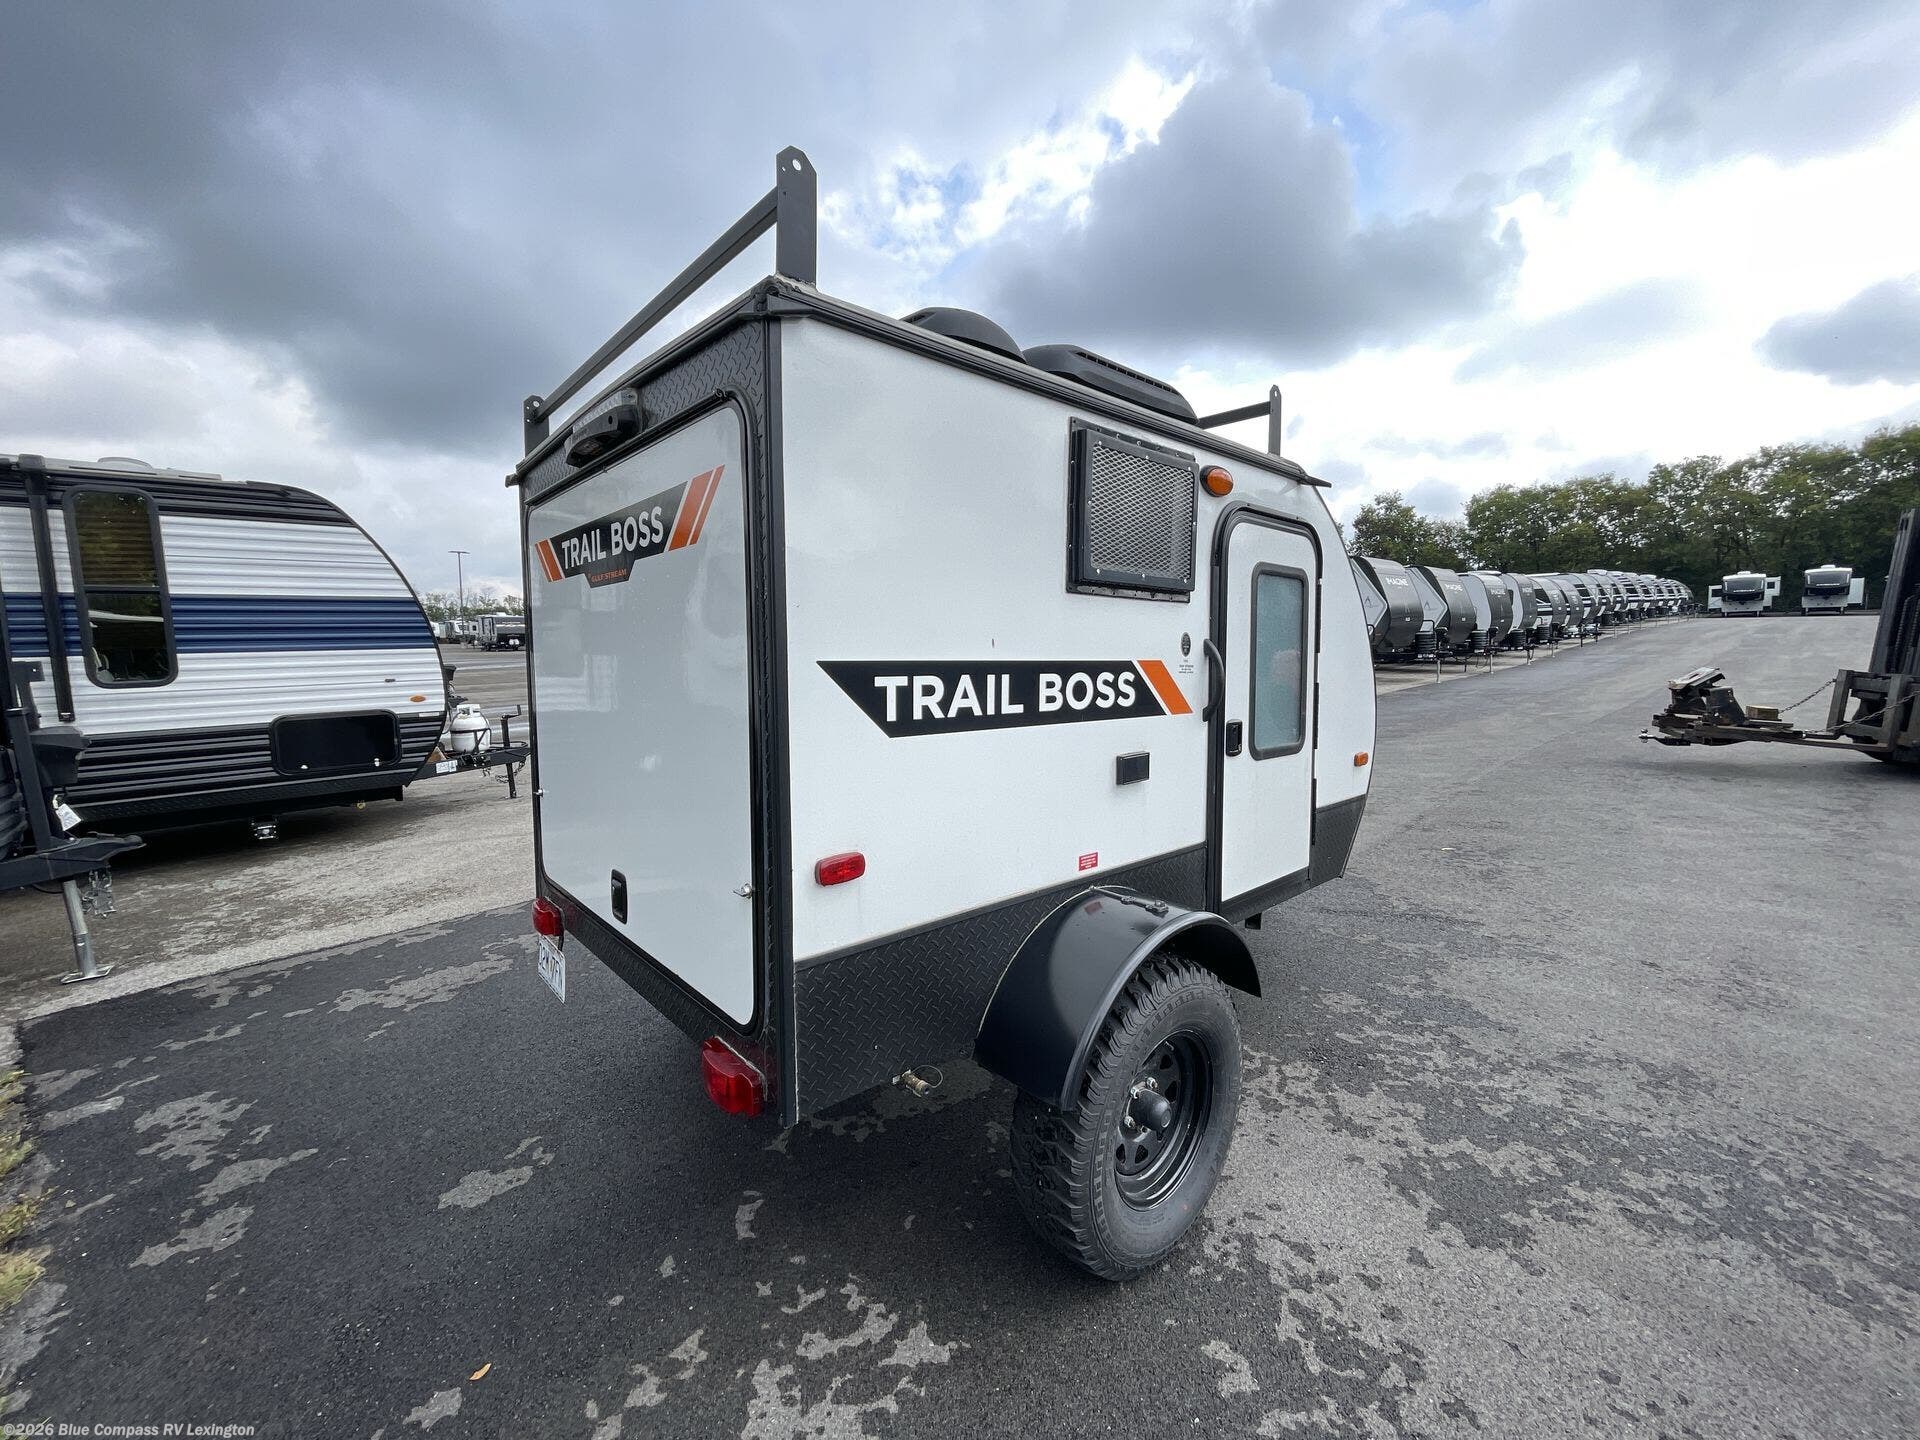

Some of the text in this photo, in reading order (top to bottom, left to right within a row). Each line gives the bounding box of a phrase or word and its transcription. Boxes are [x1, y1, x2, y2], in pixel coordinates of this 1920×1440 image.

[562, 506, 664, 570] TRAIL BOSS
[874, 671, 1137, 722] TRAIL BOSS
